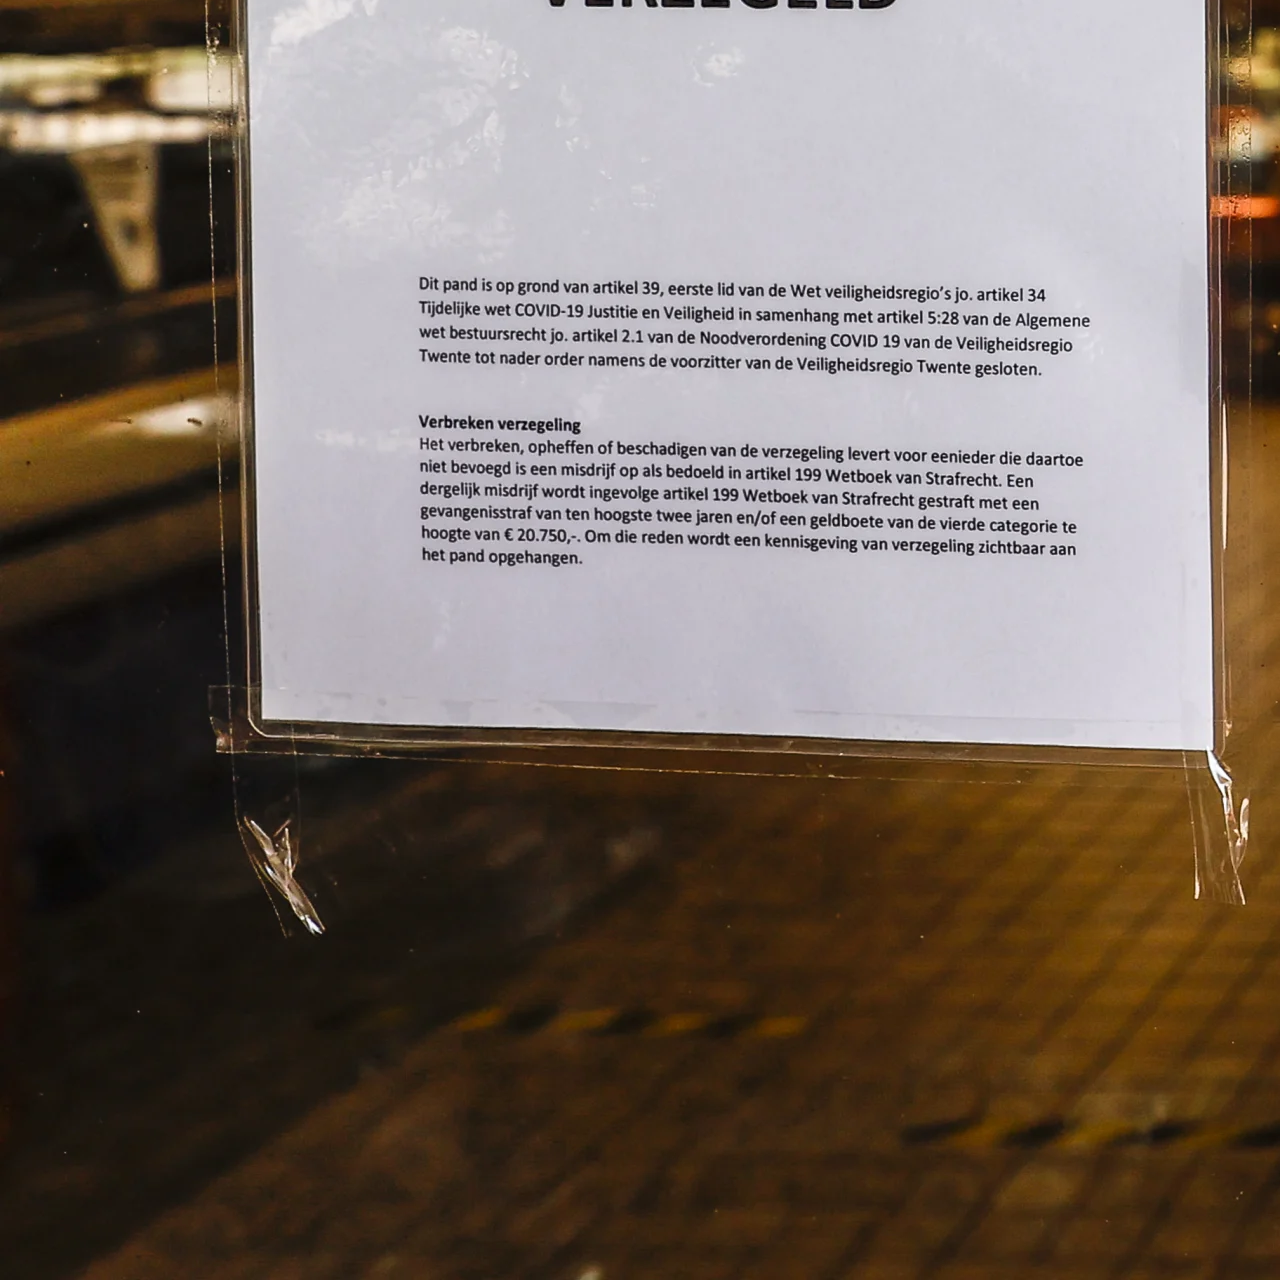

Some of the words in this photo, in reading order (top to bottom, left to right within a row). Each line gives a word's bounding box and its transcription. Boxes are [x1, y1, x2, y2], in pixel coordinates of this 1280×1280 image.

[420, 277, 438, 290] Dit
[444, 278, 477, 293] pand
[482, 278, 492, 291] is
[496, 282, 514, 295] op
[518, 280, 559, 295] grond
[563, 283, 589, 293] van
[593, 281, 638, 294] artikel
[642, 282, 664, 297] 39,
[668, 284, 713, 296] eerste
[718, 282, 734, 296] lid
[739, 287, 764, 296] van
[769, 284, 786, 297] de
[791, 285, 821, 298] Wet
[954, 287, 972, 303] jo.
[977, 288, 1023, 302] artikel
[1028, 289, 1045, 302] 34
[419, 301, 480, 318] Tijdelijke
[485, 304, 511, 316] wet
[515, 303, 583, 317] COVID-19
[588, 305, 638, 318] Justitie
[642, 309, 659, 319] en
[664, 306, 734, 323] Veiligheid
[739, 308, 751, 320] in
[756, 308, 839, 326] samenhang
[844, 311, 873, 323] met
[877, 310, 923, 324] artikel
[928, 311, 959, 325] 5:28
[963, 315, 988, 325] van
[993, 313, 1011, 326] de
[1016, 313, 1090, 330] Algemene
[420, 327, 445, 338] wet
[450, 326, 546, 341] bestuursrecht
[550, 328, 567, 344] jo.
[572, 329, 617, 342] artikel
[622, 329, 643, 343] 2.1
[648, 333, 673, 343] van
[678, 330, 695, 344] de
[701, 331, 826, 350] Noodverordening
[831, 334, 878, 347] COVID
[883, 335, 900, 348] 19
[904, 338, 930, 348] van
[935, 335, 952, 349] de
[956, 337, 1072, 355] Veiligheidsregio
[419, 349, 470, 363] Twente
[475, 352, 495, 364] tot
[500, 351, 541, 365] nader
[545, 352, 584, 366] order
[589, 356, 645, 367] namens
[649, 354, 666, 367] de
[670, 355, 741, 369] voorzitter
[745, 359, 770, 369] van
[775, 356, 793, 370] de
[797, 357, 913, 375] Veiligheidsregio
[917, 360, 971, 374] Twente
[975, 361, 1041, 378] gesloten.
[419, 415, 494, 429] Verbreken
[498, 418, 581, 435] verzegeling
[420, 438, 444, 451] Het
[448, 438, 524, 455] verbreken,
[528, 440, 593, 456] opheffen
[598, 441, 613, 454] of
[617, 441, 706, 459] beschadigen
[711, 447, 736, 456] van
[741, 444, 758, 457] de
[762, 446, 844, 463] verzegeling
[848, 447, 890, 461] levert
[894, 451, 927, 462] voor
[931, 450, 995, 464] eenieder
[1000, 451, 1021, 465] die
[1026, 452, 1083, 466] daartoe
[421, 505, 532, 521] gevangenisstraf
[535, 510, 561, 520] van
[565, 508, 589, 520] ten
[594, 507, 652, 524] hoogste
[656, 510, 692, 522] twee
[696, 510, 732, 526] jaren
[737, 510, 776, 526] en/of
[780, 515, 806, 525] een
[810, 513, 883, 529] geldboete
[887, 518, 913, 529] van
[918, 516, 936, 529] de
[940, 517, 985, 531] vierde
[990, 520, 1057, 535] categorie
[1062, 522, 1076, 533] te
[422, 525, 471, 543] hoogte
[475, 530, 500, 540] van
[504, 528, 513, 541] €
[585, 530, 611, 542] Om
[615, 530, 637, 543] die
[642, 531, 683, 544] reden
[687, 532, 730, 545] wordt
[734, 536, 760, 546] een
[765, 534, 857, 553] kennisgeving
[861, 540, 887, 550] van
[892, 539, 974, 556] verzegeling
[979, 540, 1045, 554] zichtbaar
[1050, 545, 1076, 555] aan
